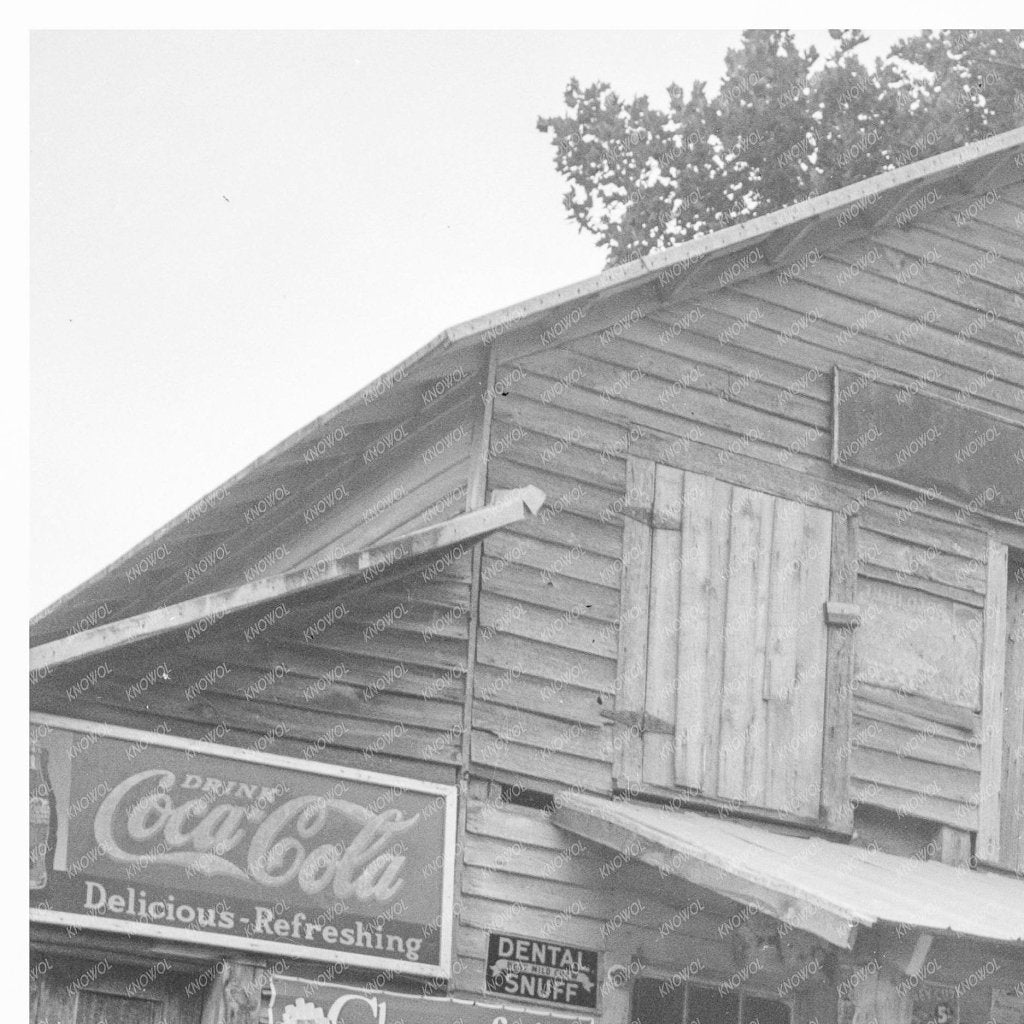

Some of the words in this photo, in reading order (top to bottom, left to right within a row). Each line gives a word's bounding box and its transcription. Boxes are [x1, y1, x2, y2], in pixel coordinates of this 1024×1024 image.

[181, 774, 280, 803] DRINK
[94, 769, 420, 902] Coca-Cola
[498, 937, 590, 971] DENTAL
[505, 973, 578, 1002] SNUFF
